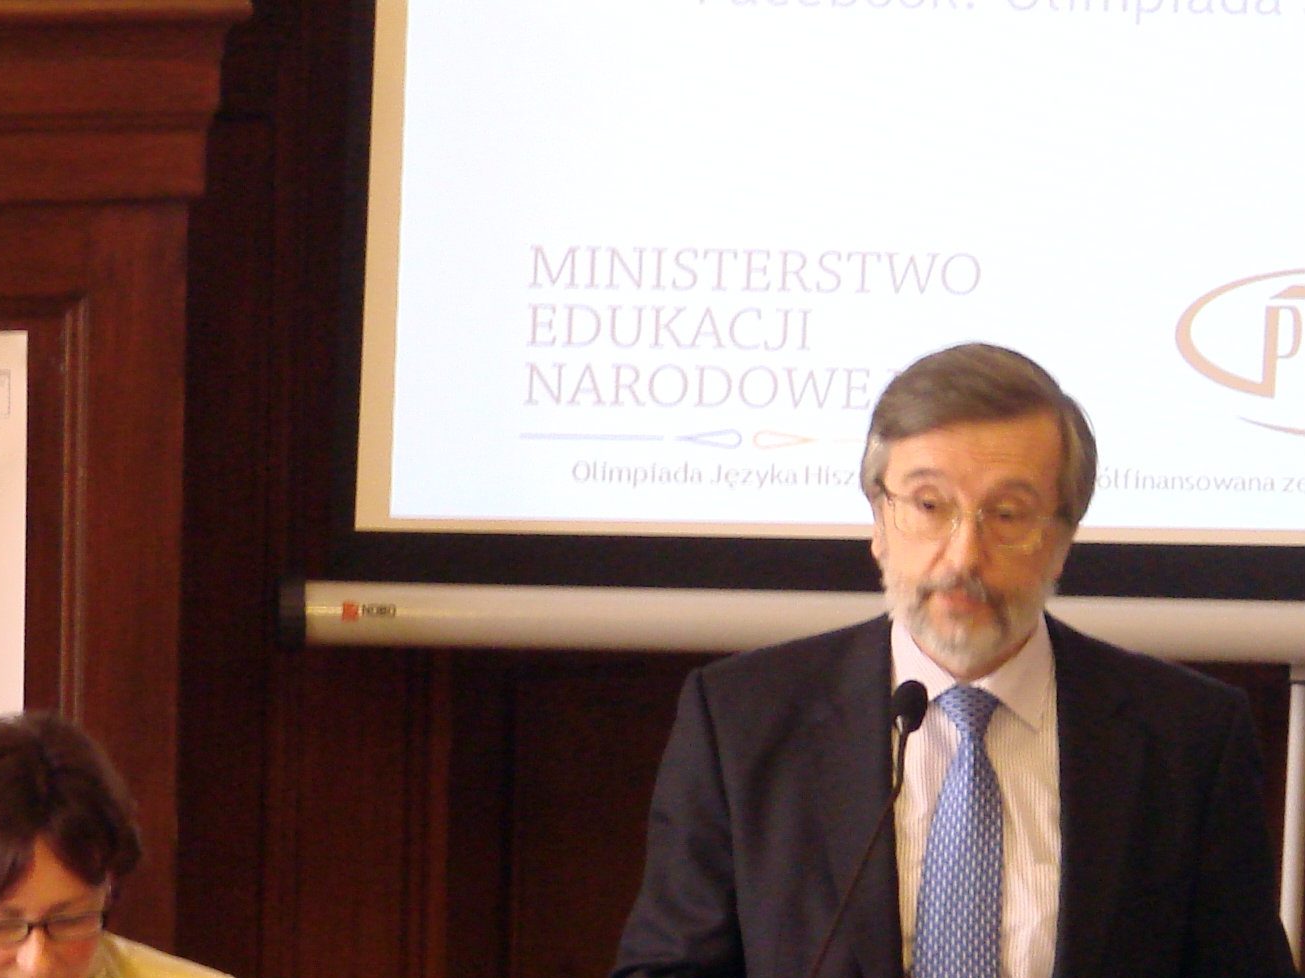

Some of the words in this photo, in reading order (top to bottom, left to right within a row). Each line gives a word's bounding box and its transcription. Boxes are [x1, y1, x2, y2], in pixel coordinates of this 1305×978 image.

[528, 244, 982, 295] MINISTERSTWO
[526, 302, 813, 351] EDUKACJI
[526, 362, 903, 410] NARODOWE
[571, 460, 703, 489] Olimpiada
[710, 463, 798, 490] Języka
[804, 464, 862, 490] Hisz
